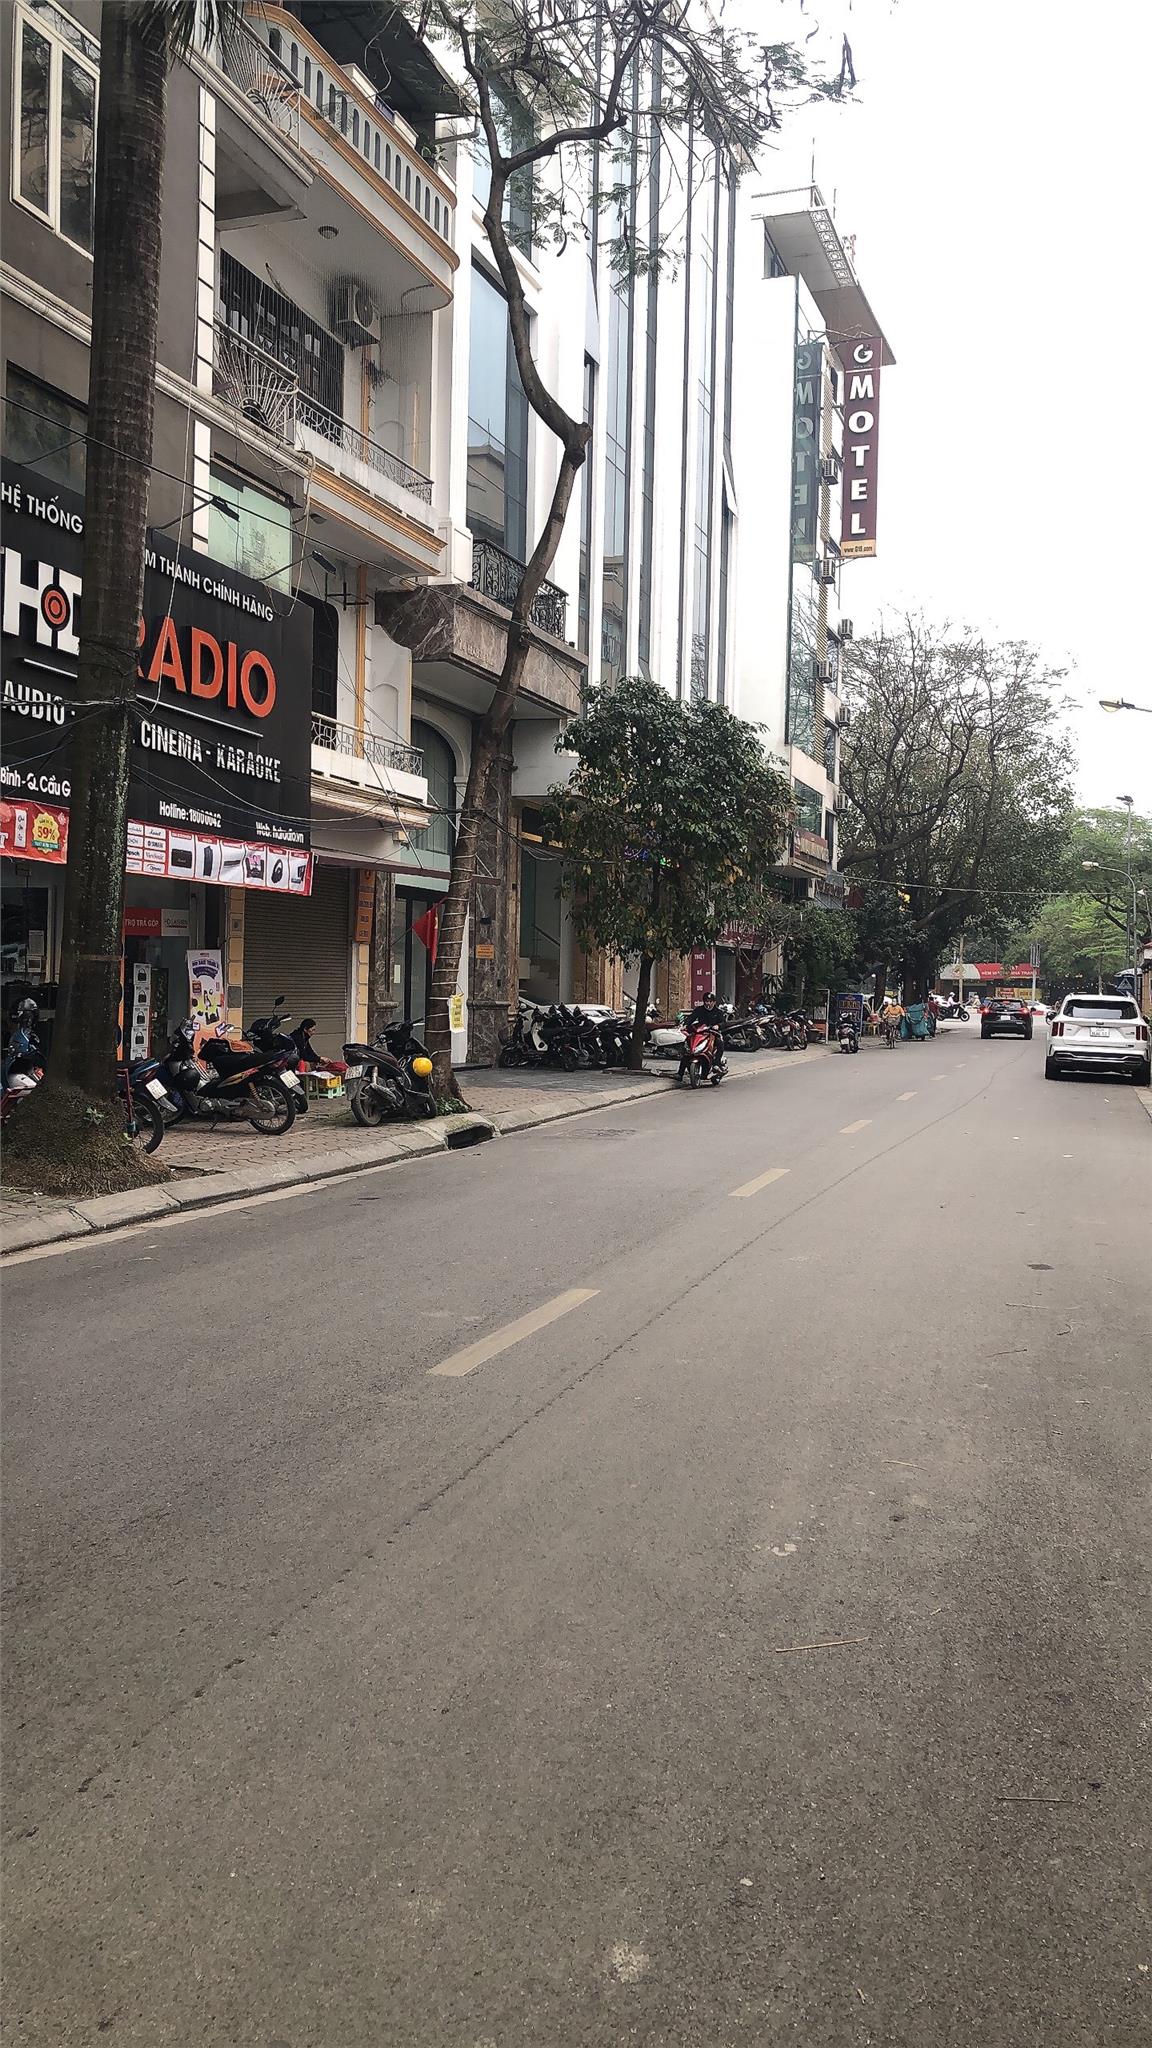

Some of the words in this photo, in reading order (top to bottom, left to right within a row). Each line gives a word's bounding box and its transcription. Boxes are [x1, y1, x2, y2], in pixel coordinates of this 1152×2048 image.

[848, 374, 874, 535] MOTEL
[1, 482, 21, 513] HỆ
[26, 495, 83, 533] THỐNG
[145, 549, 156, 569] M
[159, 556, 200, 590] THANH
[203, 577, 240, 607] CHÍNH
[242, 593, 274, 622] HÀNG
[4, 679, 65, 725] AUDIO
[140, 720, 203, 763] CINEMA
[216, 742, 281, 784] KARAOKE
[37, 826, 55, 840] 59%
[62, 780, 71, 797] G
